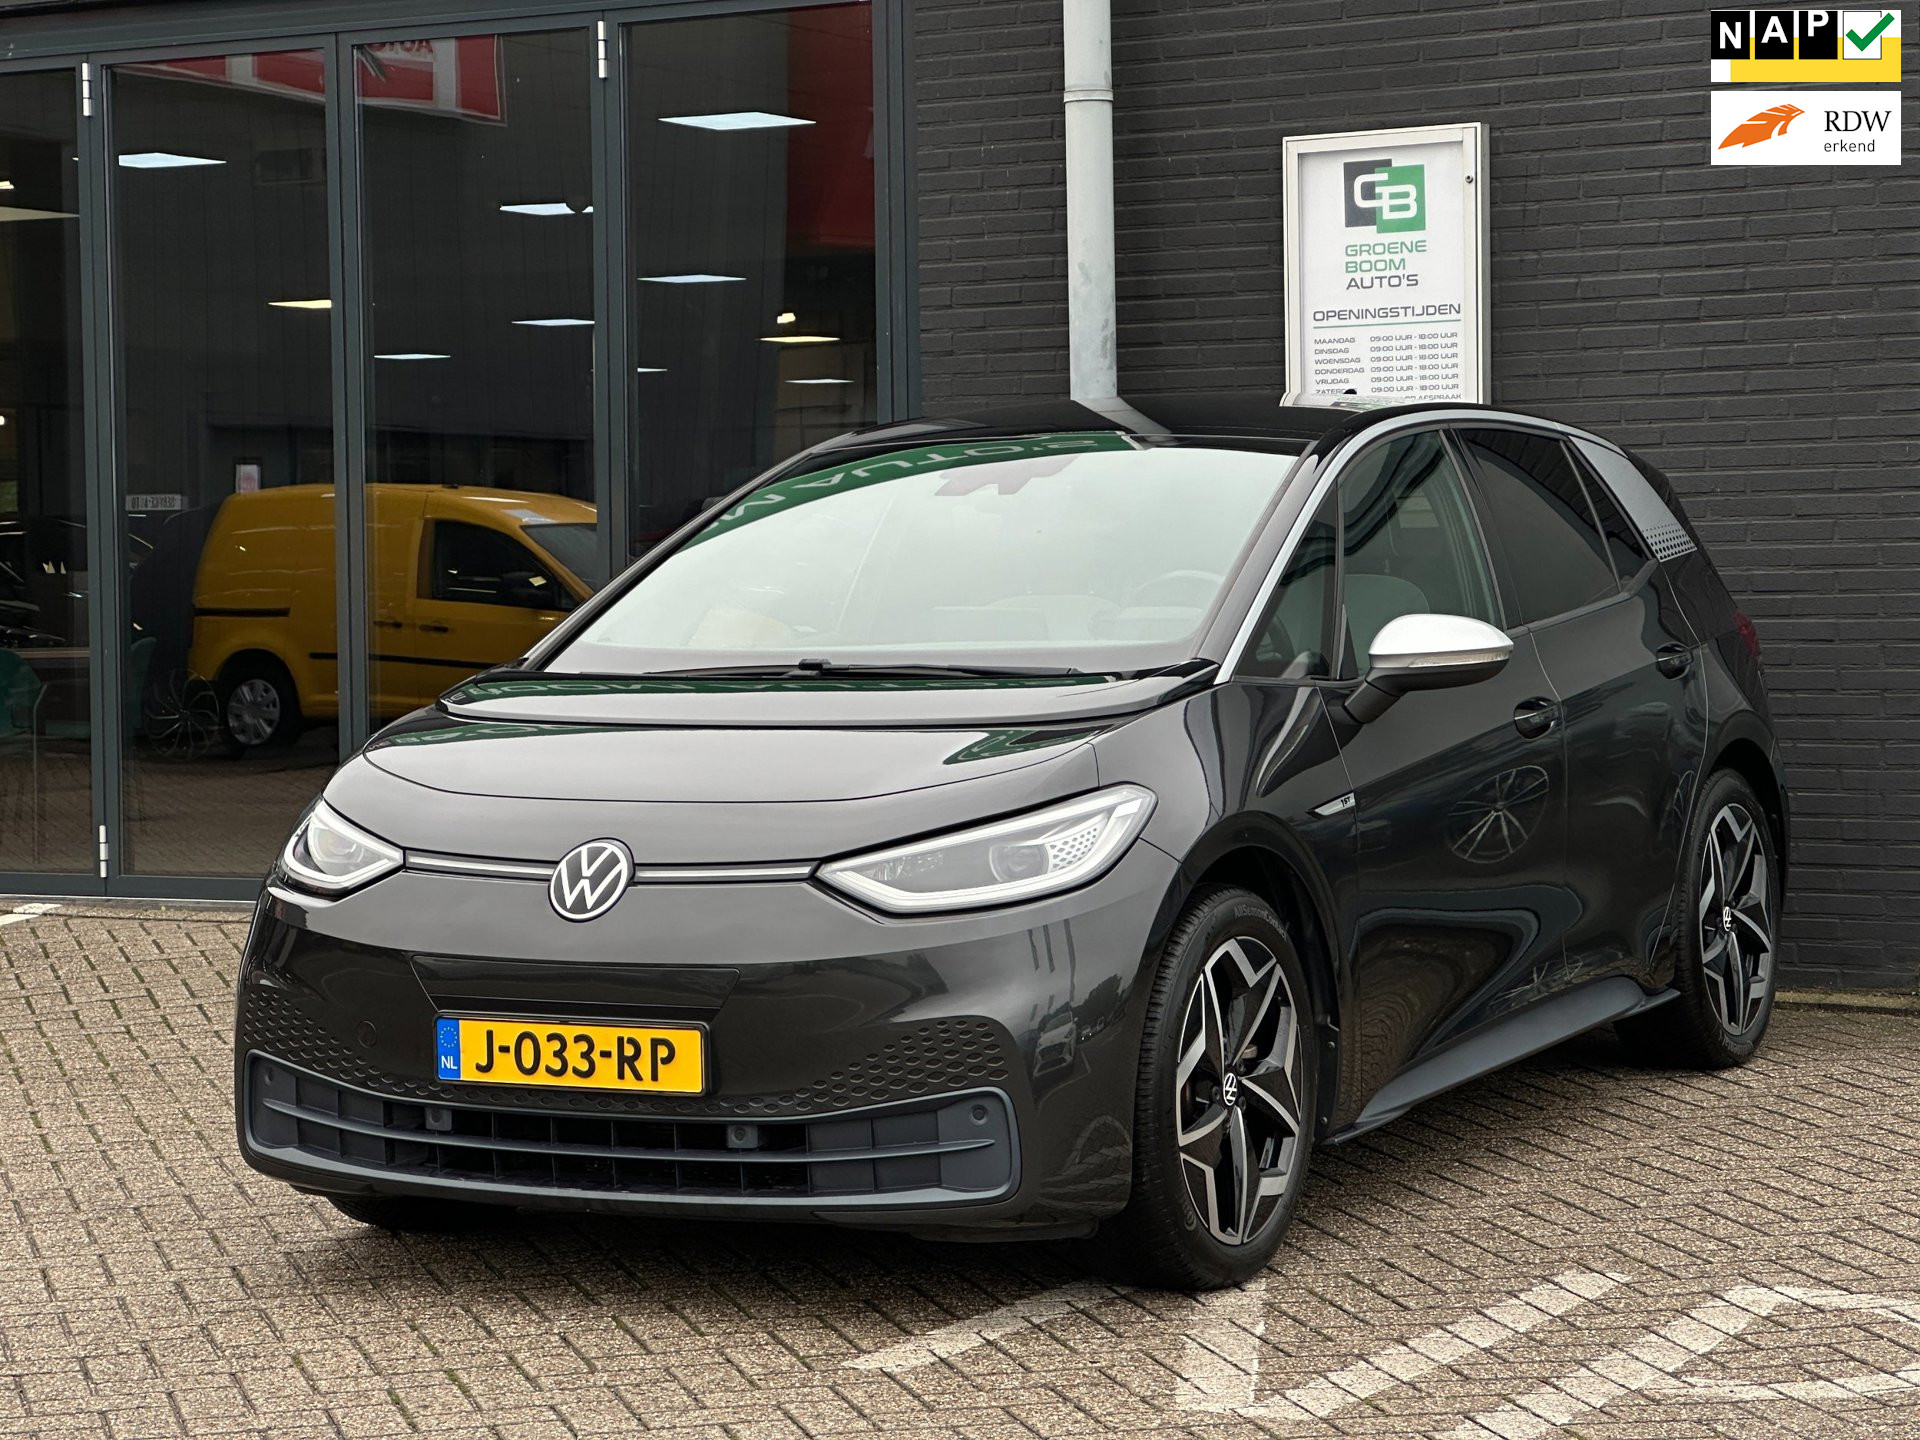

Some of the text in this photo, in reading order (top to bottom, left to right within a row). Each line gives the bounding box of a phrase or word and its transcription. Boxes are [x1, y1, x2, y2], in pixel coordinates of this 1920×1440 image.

[1345, 240, 1427, 257] GROENE
[1345, 258, 1406, 273] BOOM
[1346, 274, 1419, 290] AUTO'S
[1313, 303, 1461, 322] OPENINGSTIJDEN
[441, 1055, 458, 1070] NL
[475, 1029, 676, 1082] J-033-RP
